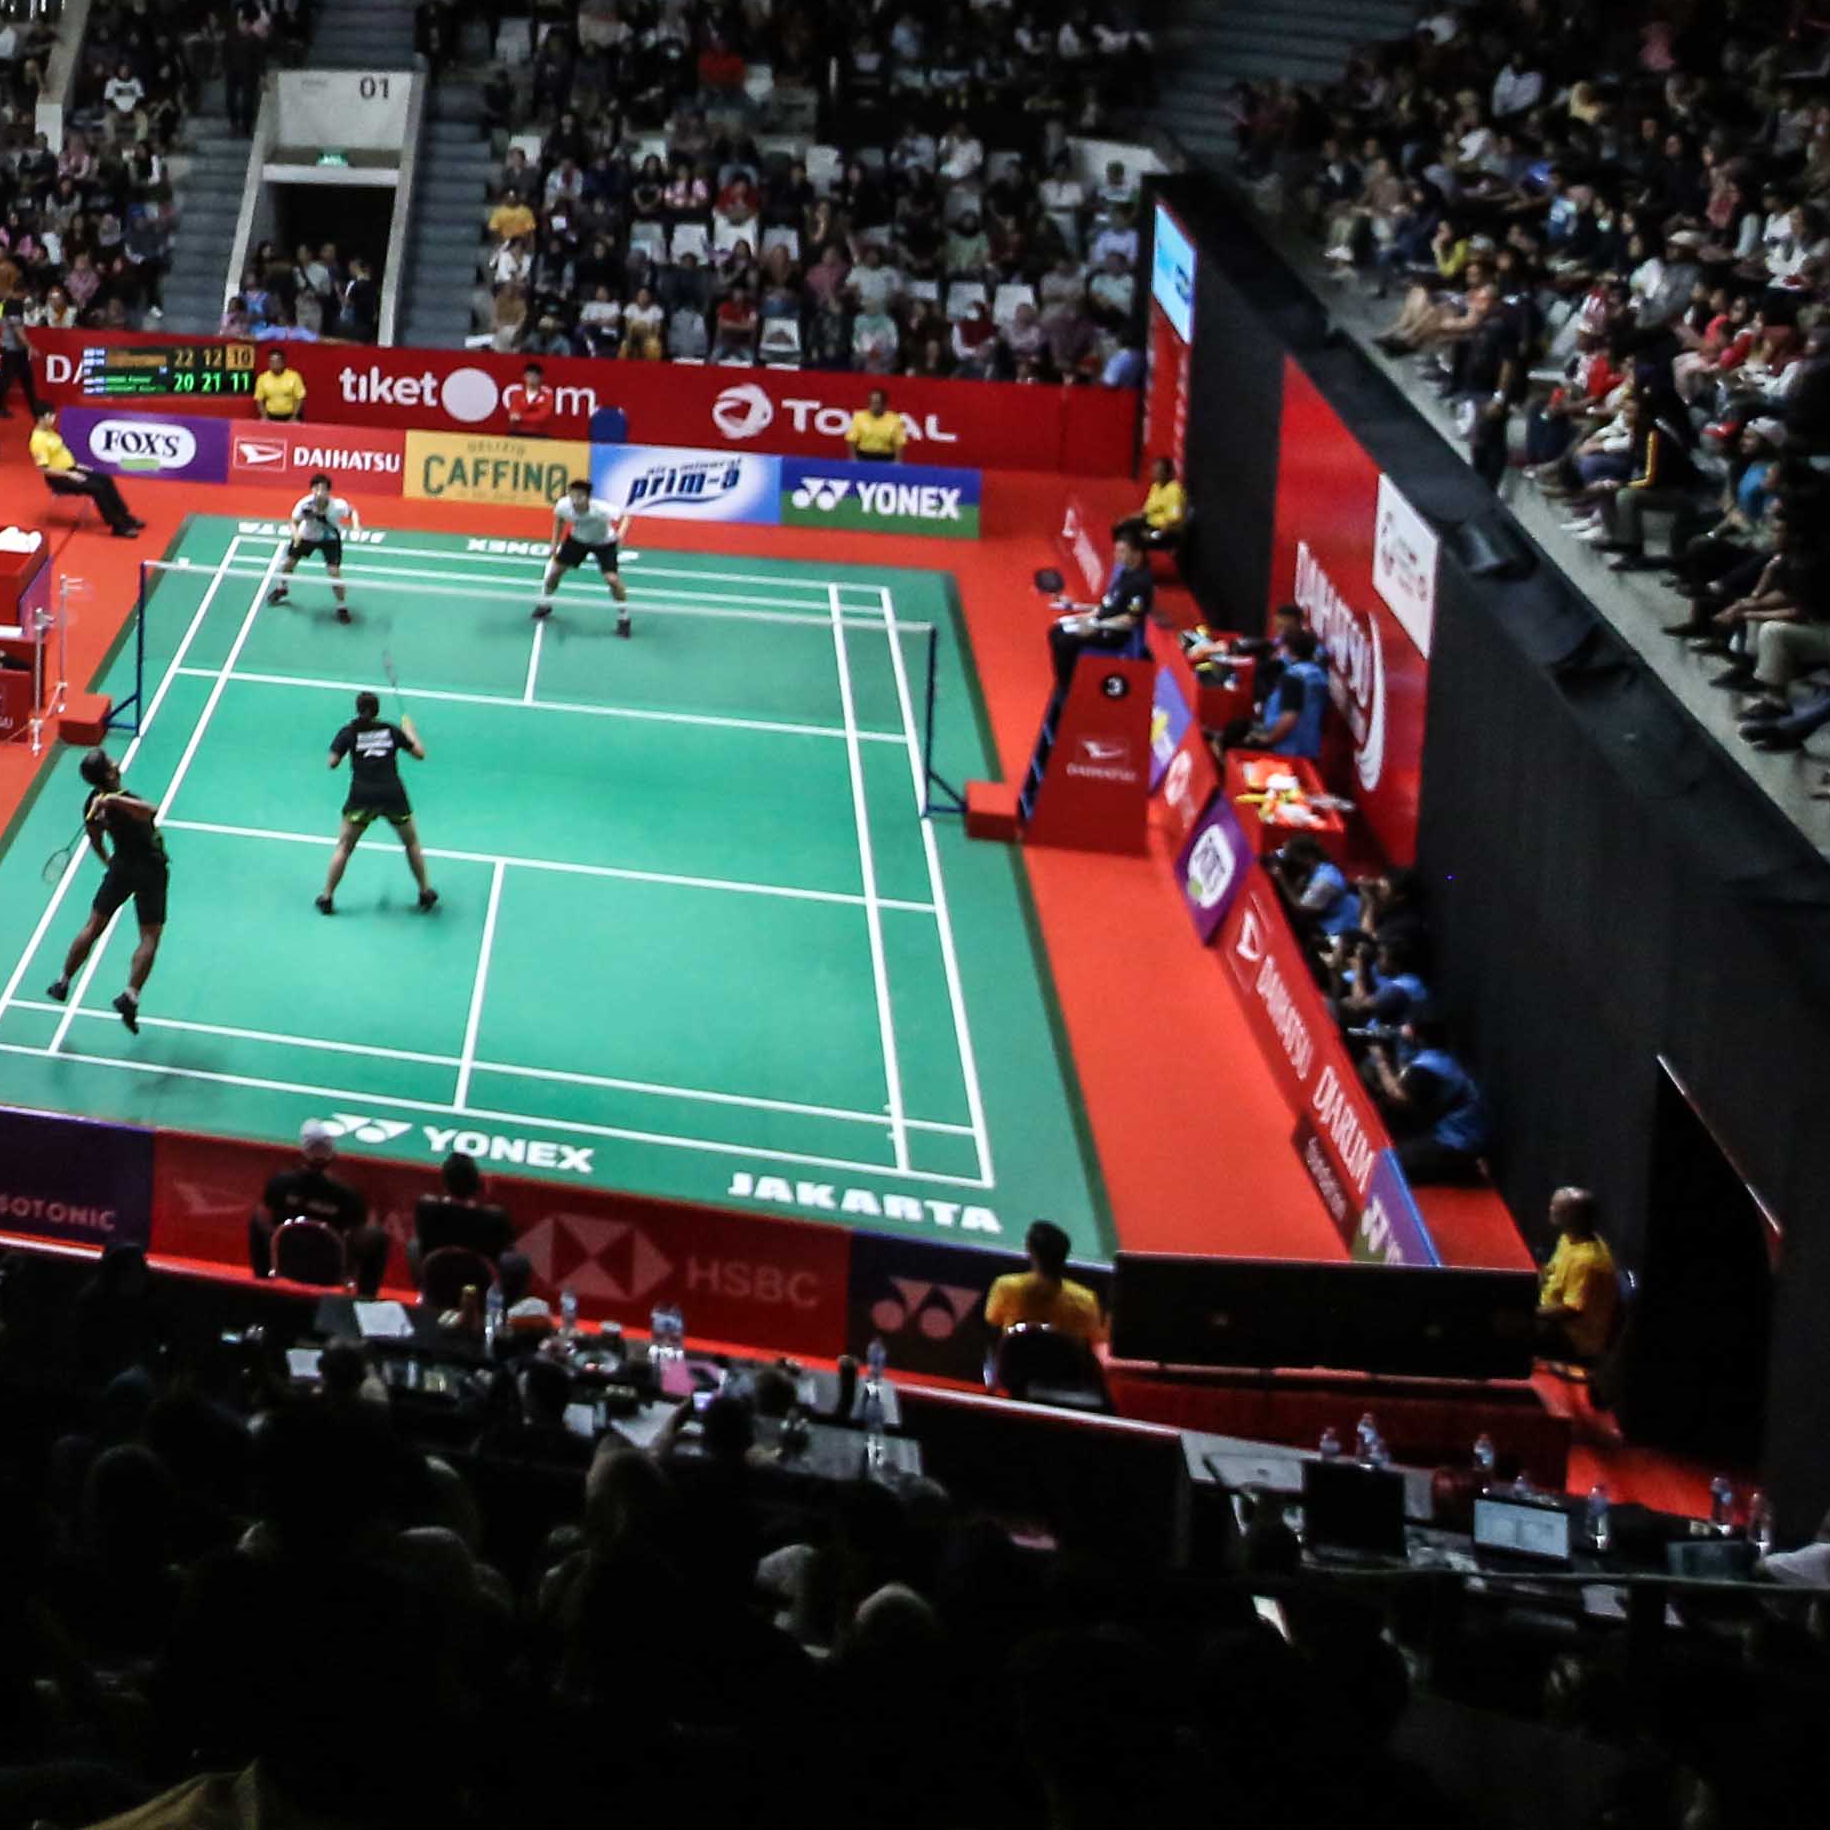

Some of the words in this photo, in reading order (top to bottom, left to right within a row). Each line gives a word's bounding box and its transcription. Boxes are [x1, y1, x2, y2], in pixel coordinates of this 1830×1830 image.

[359, 76, 390, 100] 01
[173, 348, 194, 369] 22
[203, 348, 223, 369] 12
[232, 347, 251, 366] 10
[173, 372, 195, 392] 20
[201, 372, 222, 392] 21
[228, 372, 251, 391] 11
[781, 398, 958, 443] TOAL
[102, 428, 181, 458] FOX'S
[293, 446, 400, 473] DAIHATSU
[423, 453, 568, 503] CAFFINO
[626, 467, 742, 508] prim-a
[857, 481, 960, 521] YONEX
[1107, 676, 1124, 695] 3
[422, 1124, 595, 1175] YONEX
[726, 1171, 1004, 1235] JAKARTA
[684, 1254, 820, 1309] HSBC
